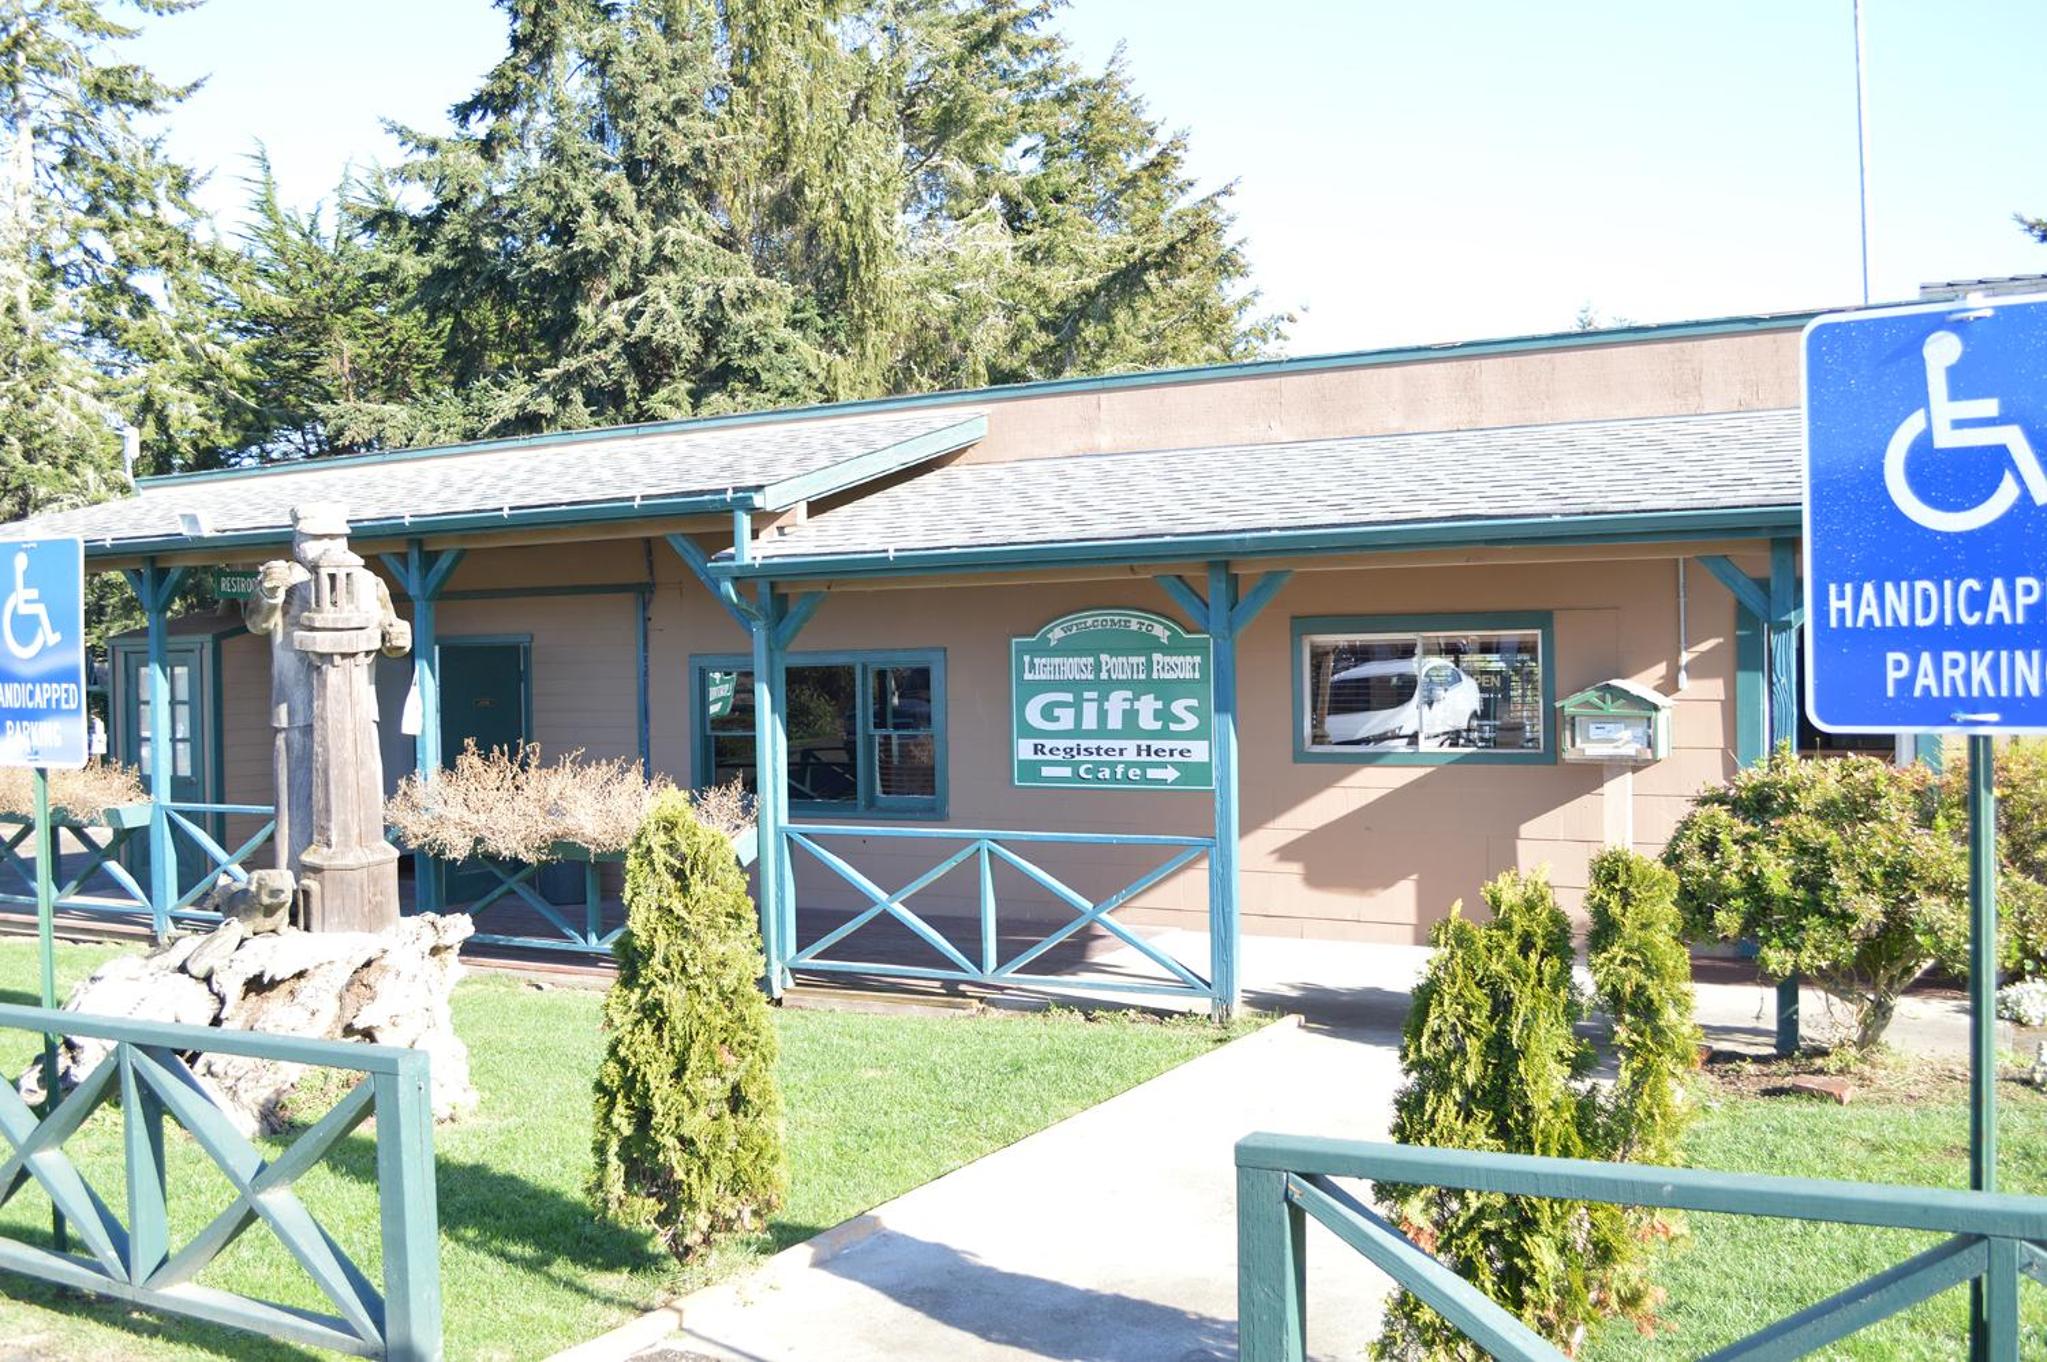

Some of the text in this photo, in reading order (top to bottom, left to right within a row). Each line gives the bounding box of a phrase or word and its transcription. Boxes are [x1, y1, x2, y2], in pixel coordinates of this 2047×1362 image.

[1828, 576, 2047, 629] HANDICAP
[1060, 618, 1155, 634] WELCOME TO
[1023, 652, 1202, 681] LIGHTHOUSE POINTE RESORT
[1885, 649, 2047, 698] PARKIN
[1473, 674, 1501, 688] PEN
[0, 682, 79, 710] ANDICAPPED
[1024, 690, 1201, 732] Gifts
[5, 720, 63, 748] PARKING
[1032, 743, 1193, 760] Register Here
[1078, 764, 1142, 780] Cafe
